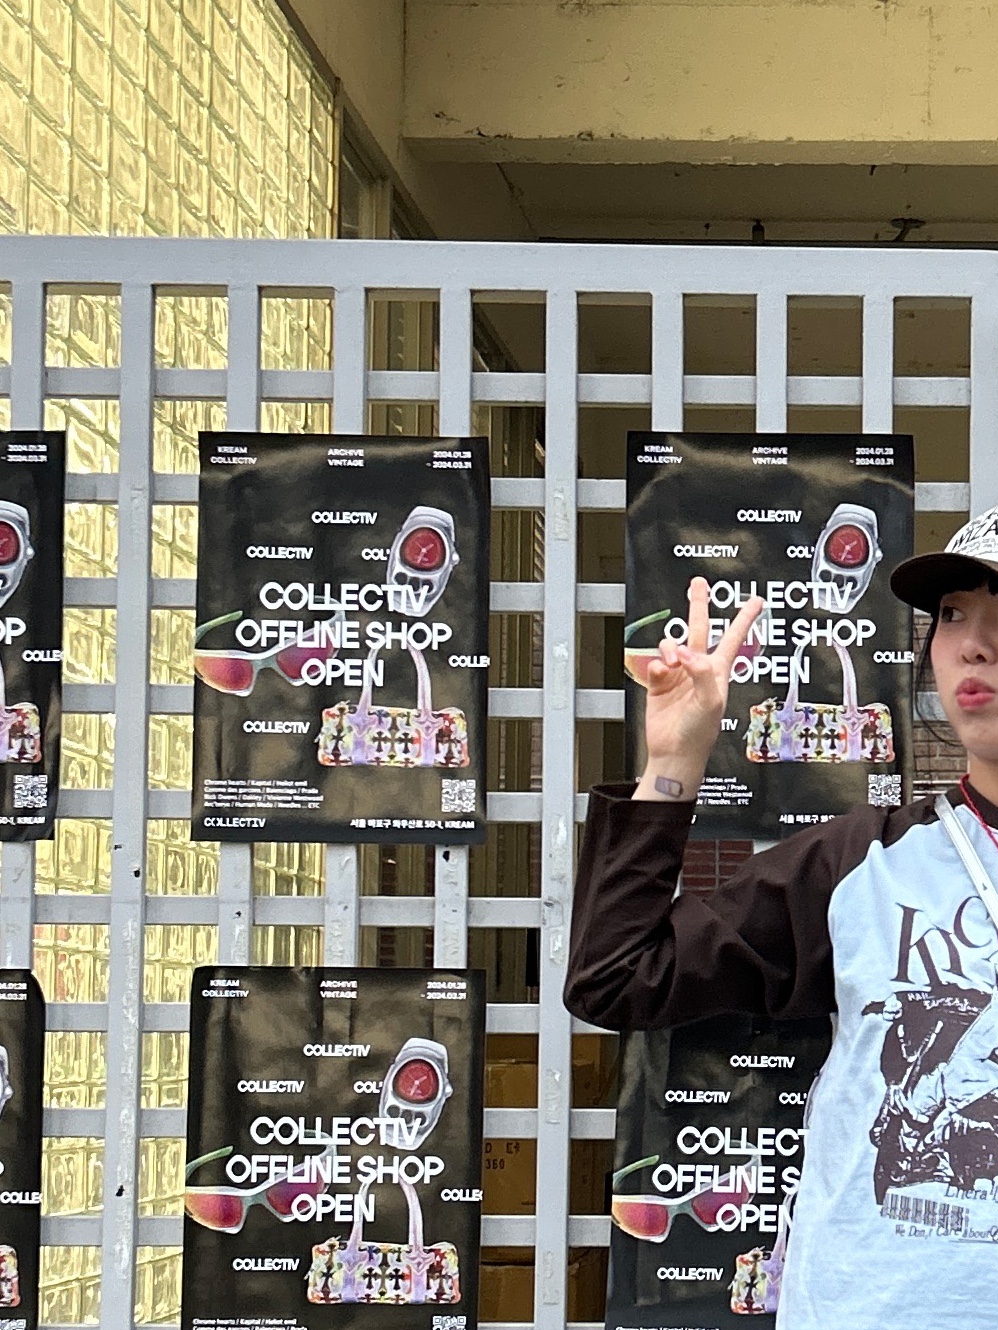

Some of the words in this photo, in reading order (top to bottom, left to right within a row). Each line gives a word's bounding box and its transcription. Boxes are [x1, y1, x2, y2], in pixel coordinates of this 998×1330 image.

[312, 512, 377, 524] COLLECTIV
[737, 510, 802, 522] COLLECTIV
[247, 546, 313, 559] COLLECTIV
[674, 545, 739, 557] COLLECTIV
[260, 583, 431, 613] COLLECTIV
[236, 620, 359, 649] OFFLINE
[366, 622, 452, 651] SHOP
[792, 619, 876, 648] SHOP
[300, 658, 383, 688] OPEN
[243, 721, 310, 733] COLLECTIV
[303, 1044, 370, 1056] COLLECTIV
[730, 1055, 795, 1068] COLLECTIV
[238, 1080, 304, 1092] COLLECTIV
[665, 1090, 730, 1103] COLLECTIV
[250, 1117, 423, 1149] COLLECTIV
[226, 1155, 351, 1186] OFFLINE
[357, 1156, 444, 1186] SHOP
[652, 1165, 775, 1194] OFFLINE
[290, 1192, 374, 1224] OPEN
[233, 1258, 299, 1270] COLLECTIV
[657, 1267, 723, 1280] COLLECTIV
